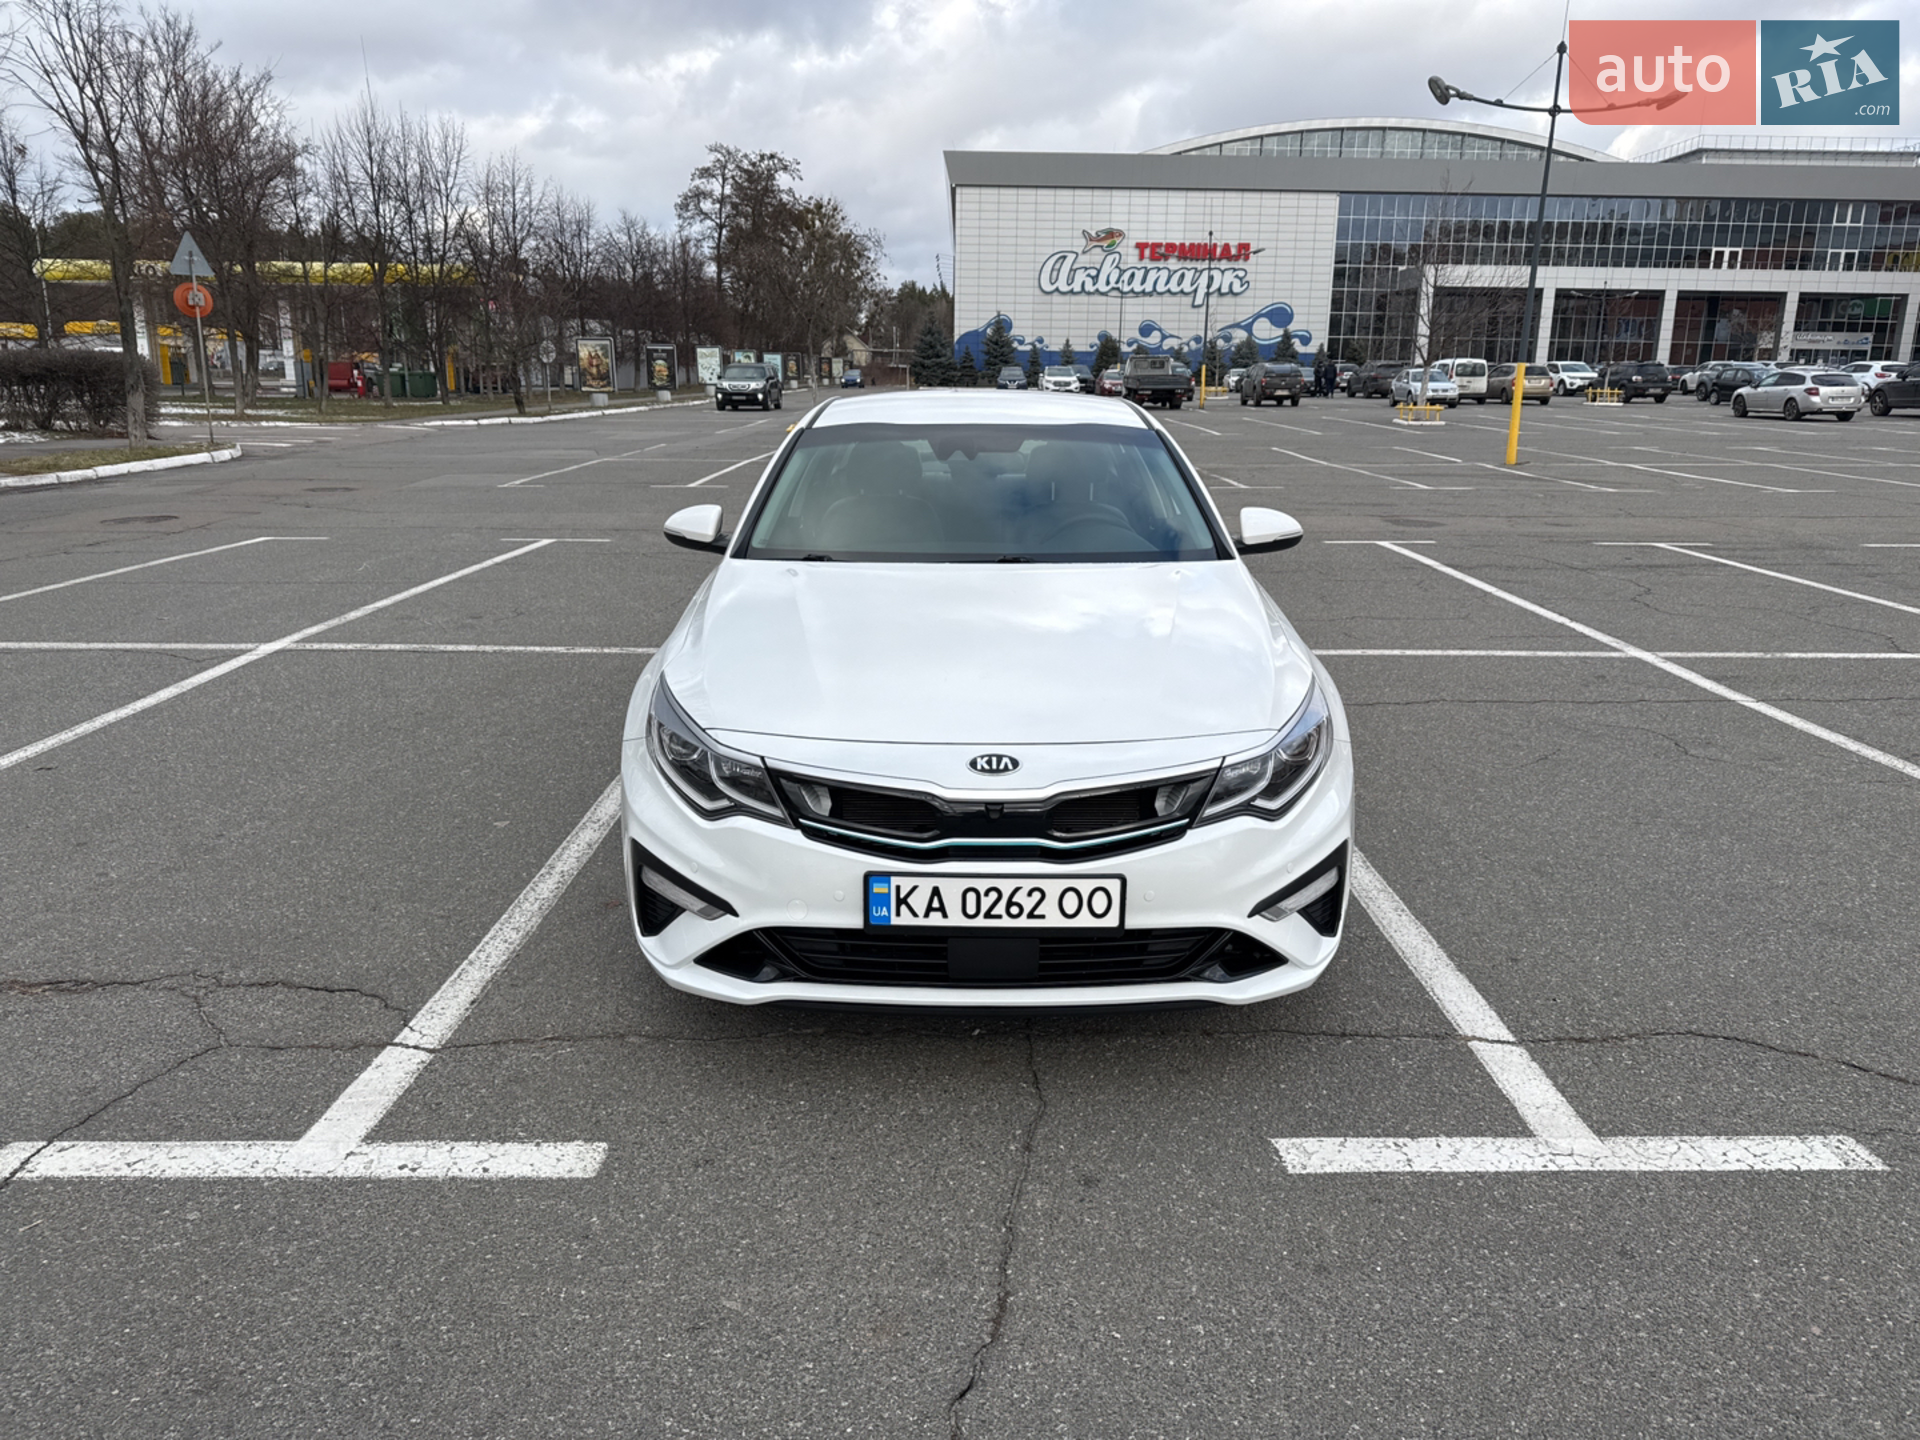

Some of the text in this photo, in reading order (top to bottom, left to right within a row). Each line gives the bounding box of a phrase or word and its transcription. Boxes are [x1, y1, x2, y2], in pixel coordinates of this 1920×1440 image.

[1135, 242, 1251, 262] ТЕРМІНАЛ
[1038, 250, 1250, 308] Аквапарк
[976, 756, 1014, 770] KIA
[872, 906, 889, 917] UA
[894, 884, 949, 919] KA
[960, 886, 1047, 920] 0262
